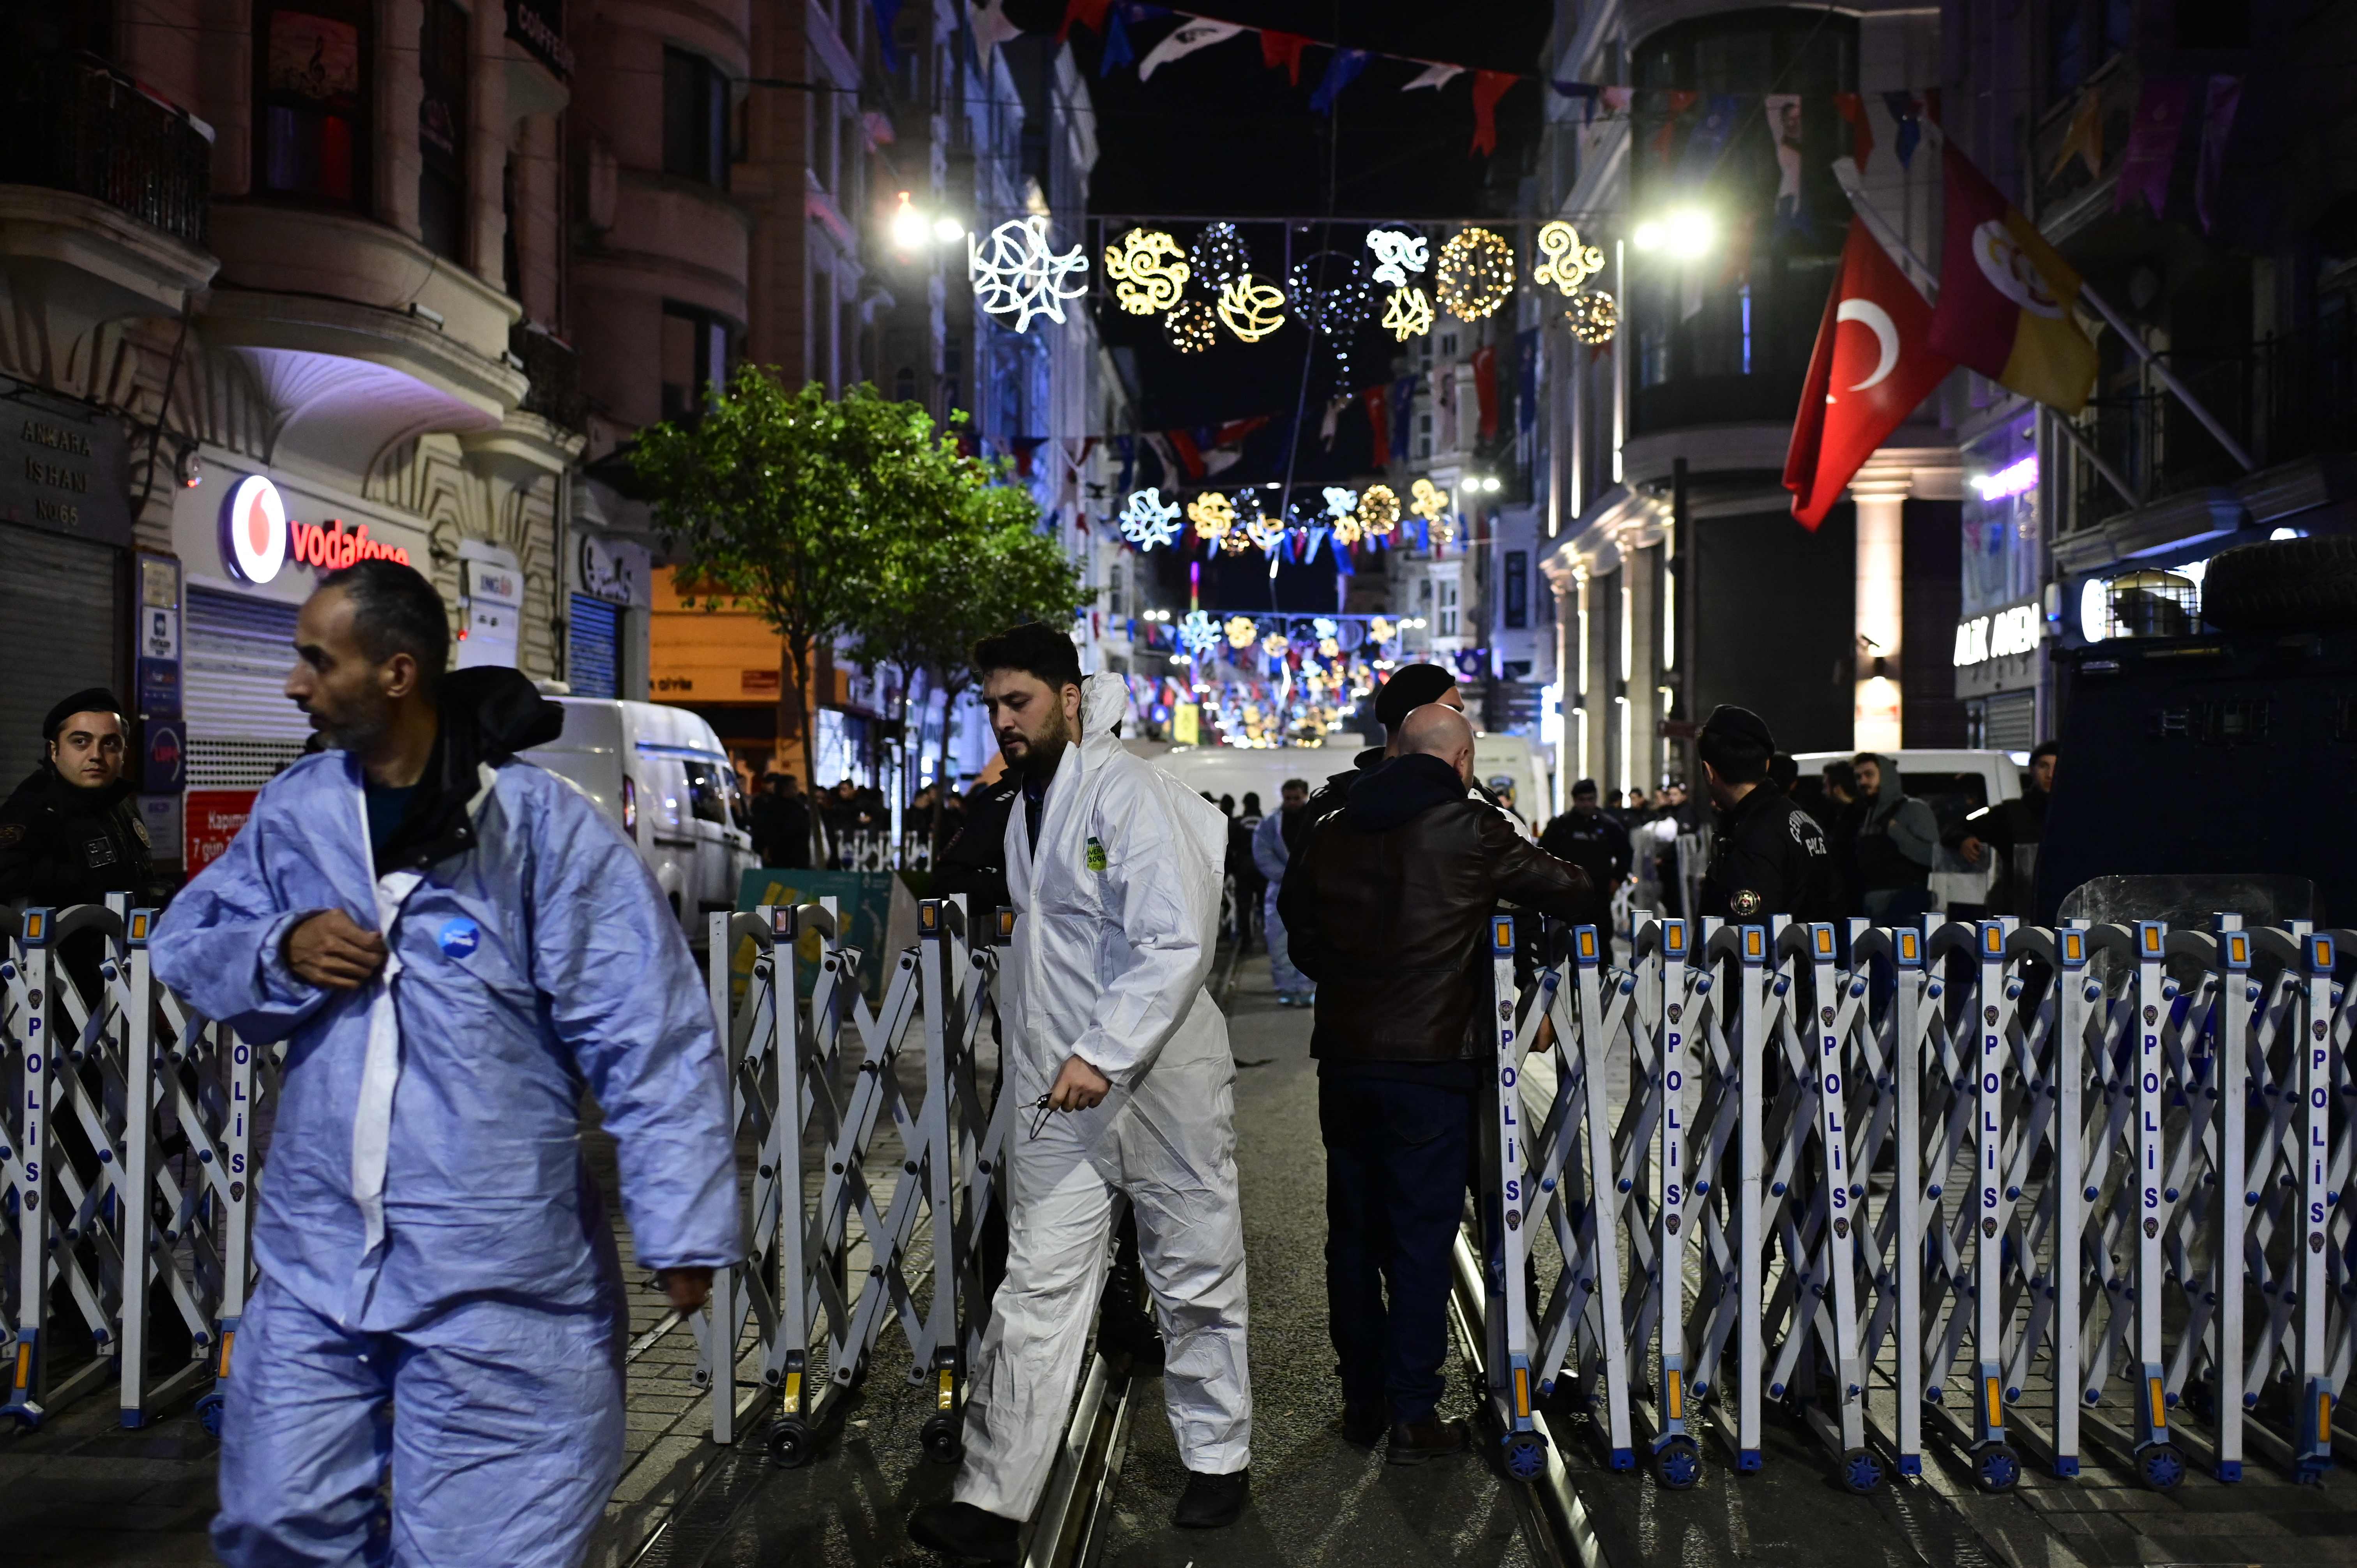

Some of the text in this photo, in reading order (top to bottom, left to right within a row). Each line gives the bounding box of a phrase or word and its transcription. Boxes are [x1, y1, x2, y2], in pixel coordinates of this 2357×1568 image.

[21, 418, 92, 456] ANKARA
[291, 519, 409, 569] vodafone
[1088, 855, 1106, 863] 3000
[27, 1018, 41, 1181] POLİS
[232, 1045, 248, 1173] OLİS
[1502, 1030, 1519, 1201] POLİS
[1667, 1033, 1681, 1204] POLİS
[1825, 1037, 1846, 1208] POLİS
[1984, 1036, 1998, 1208] POLİS
[2143, 1035, 2158, 1208] POLİS
[2311, 1050, 2326, 1223] POLİS
